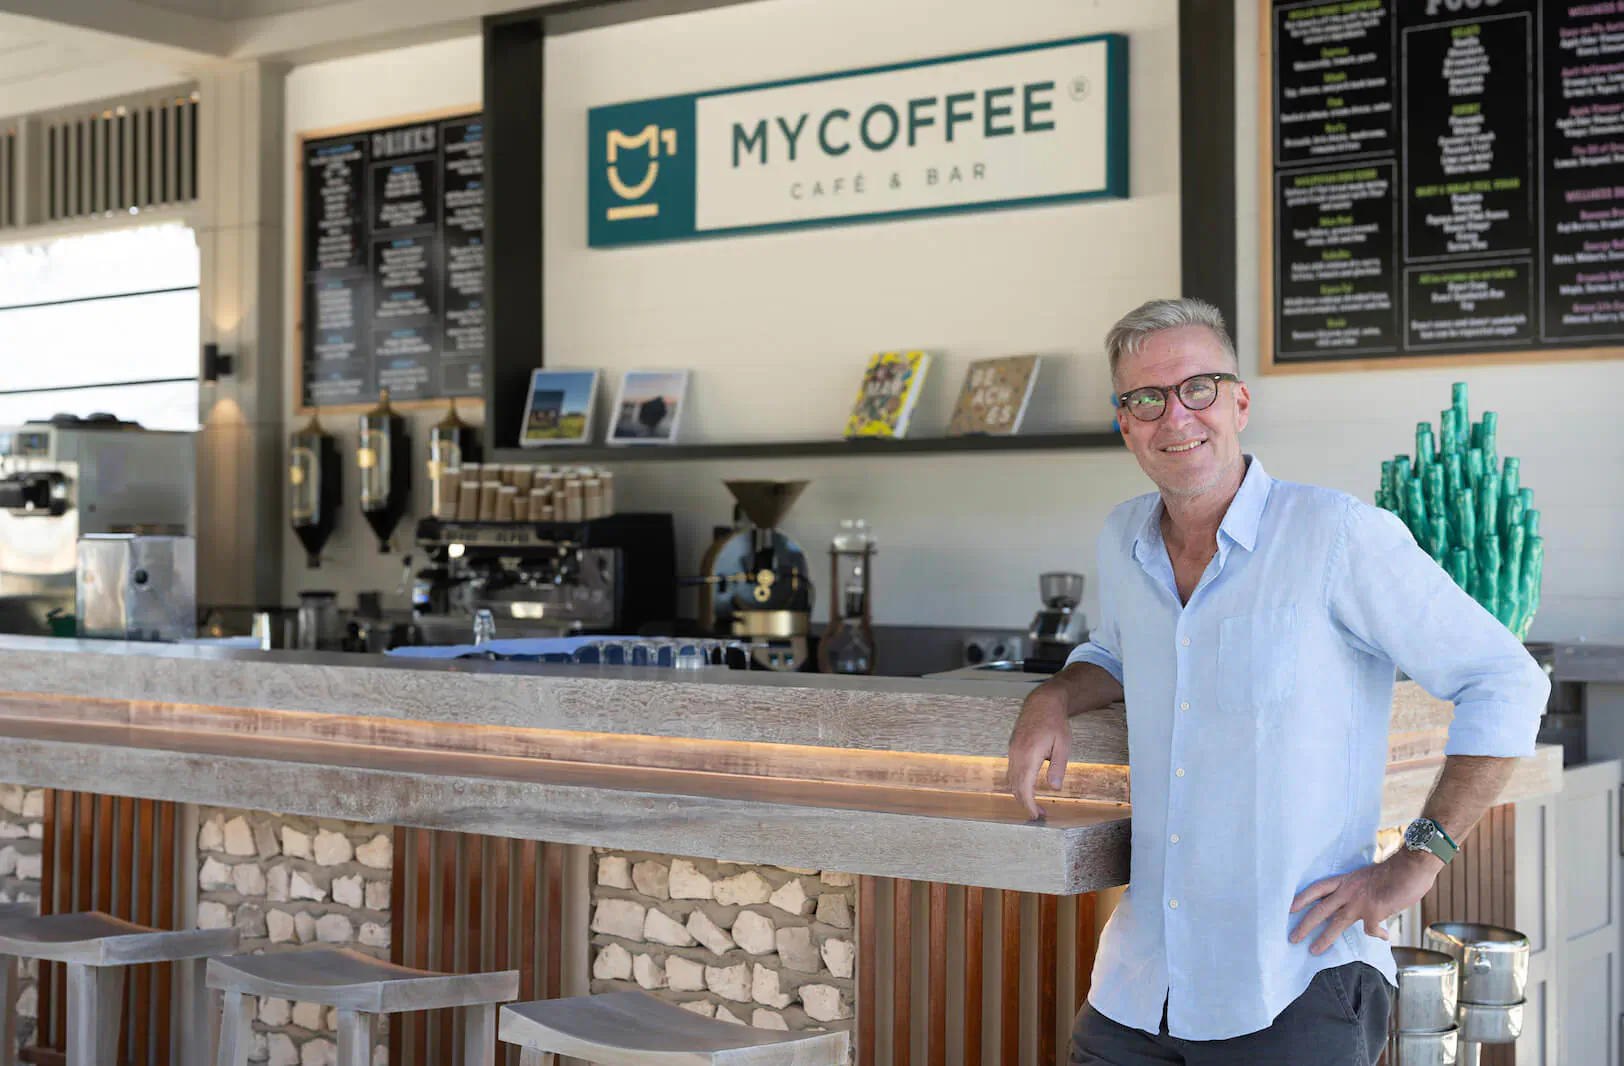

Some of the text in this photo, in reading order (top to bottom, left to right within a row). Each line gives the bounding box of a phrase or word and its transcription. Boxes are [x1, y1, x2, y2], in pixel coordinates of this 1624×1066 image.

[732, 80, 1056, 168] MYCOFFEE
[790, 162, 987, 200] CAFÉ & BAR
